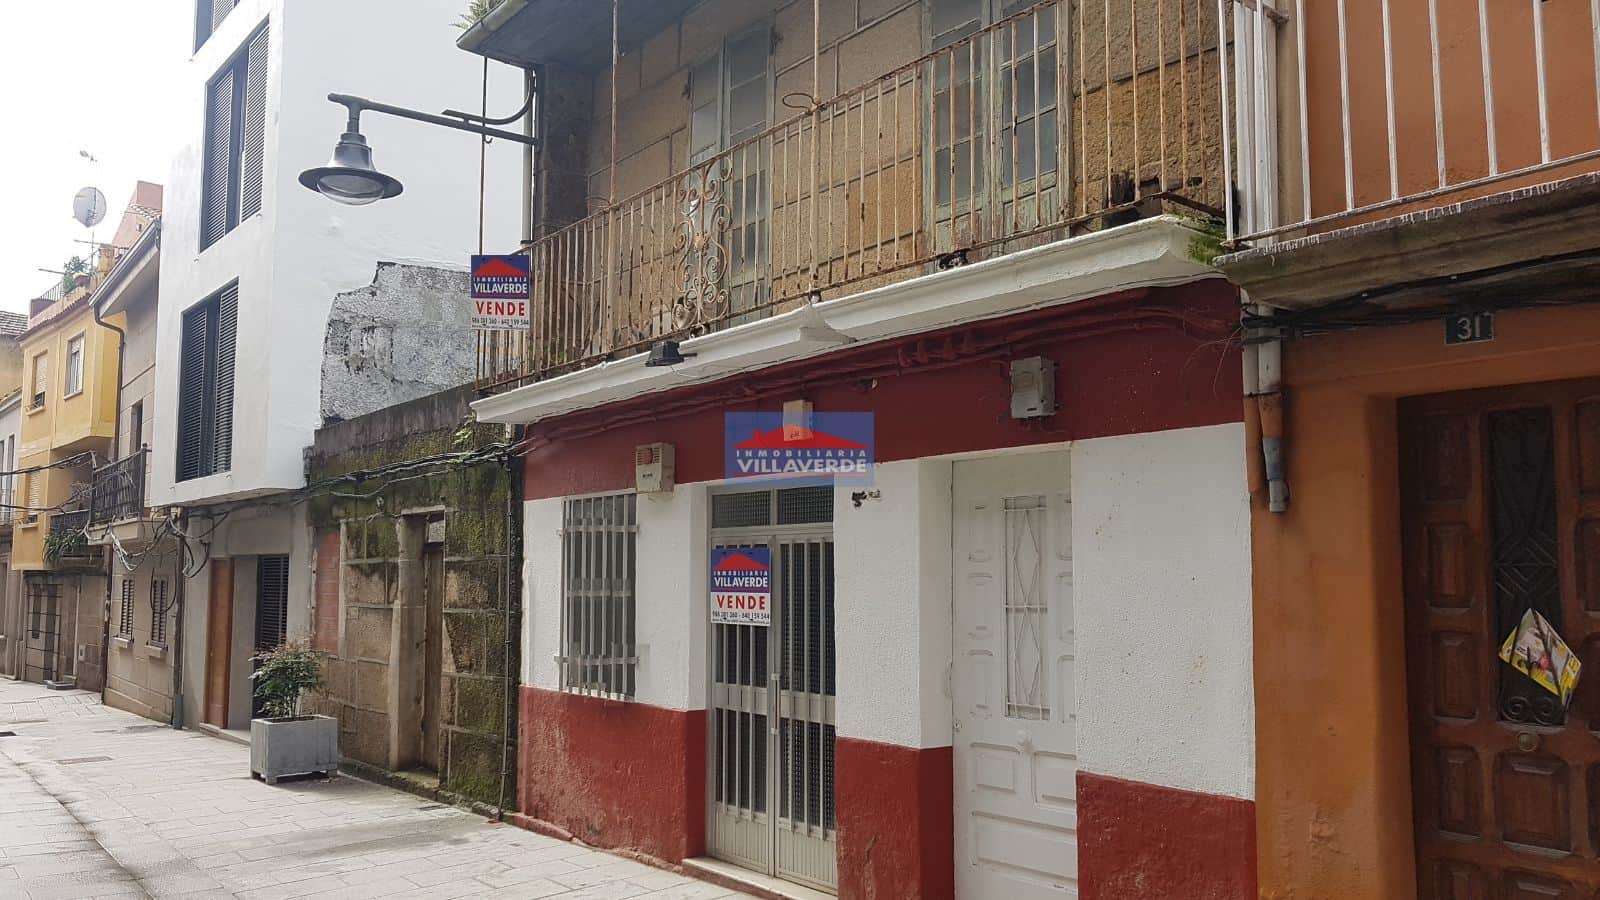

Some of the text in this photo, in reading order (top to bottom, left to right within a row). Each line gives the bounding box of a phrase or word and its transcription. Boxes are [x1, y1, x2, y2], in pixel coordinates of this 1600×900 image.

[473, 283, 528, 293] VILLAVERDE
[476, 301, 525, 316] VENDE
[1457, 316, 1480, 339] 31
[714, 577, 768, 587] VILLAVERDE
[717, 595, 766, 610] VENDE
